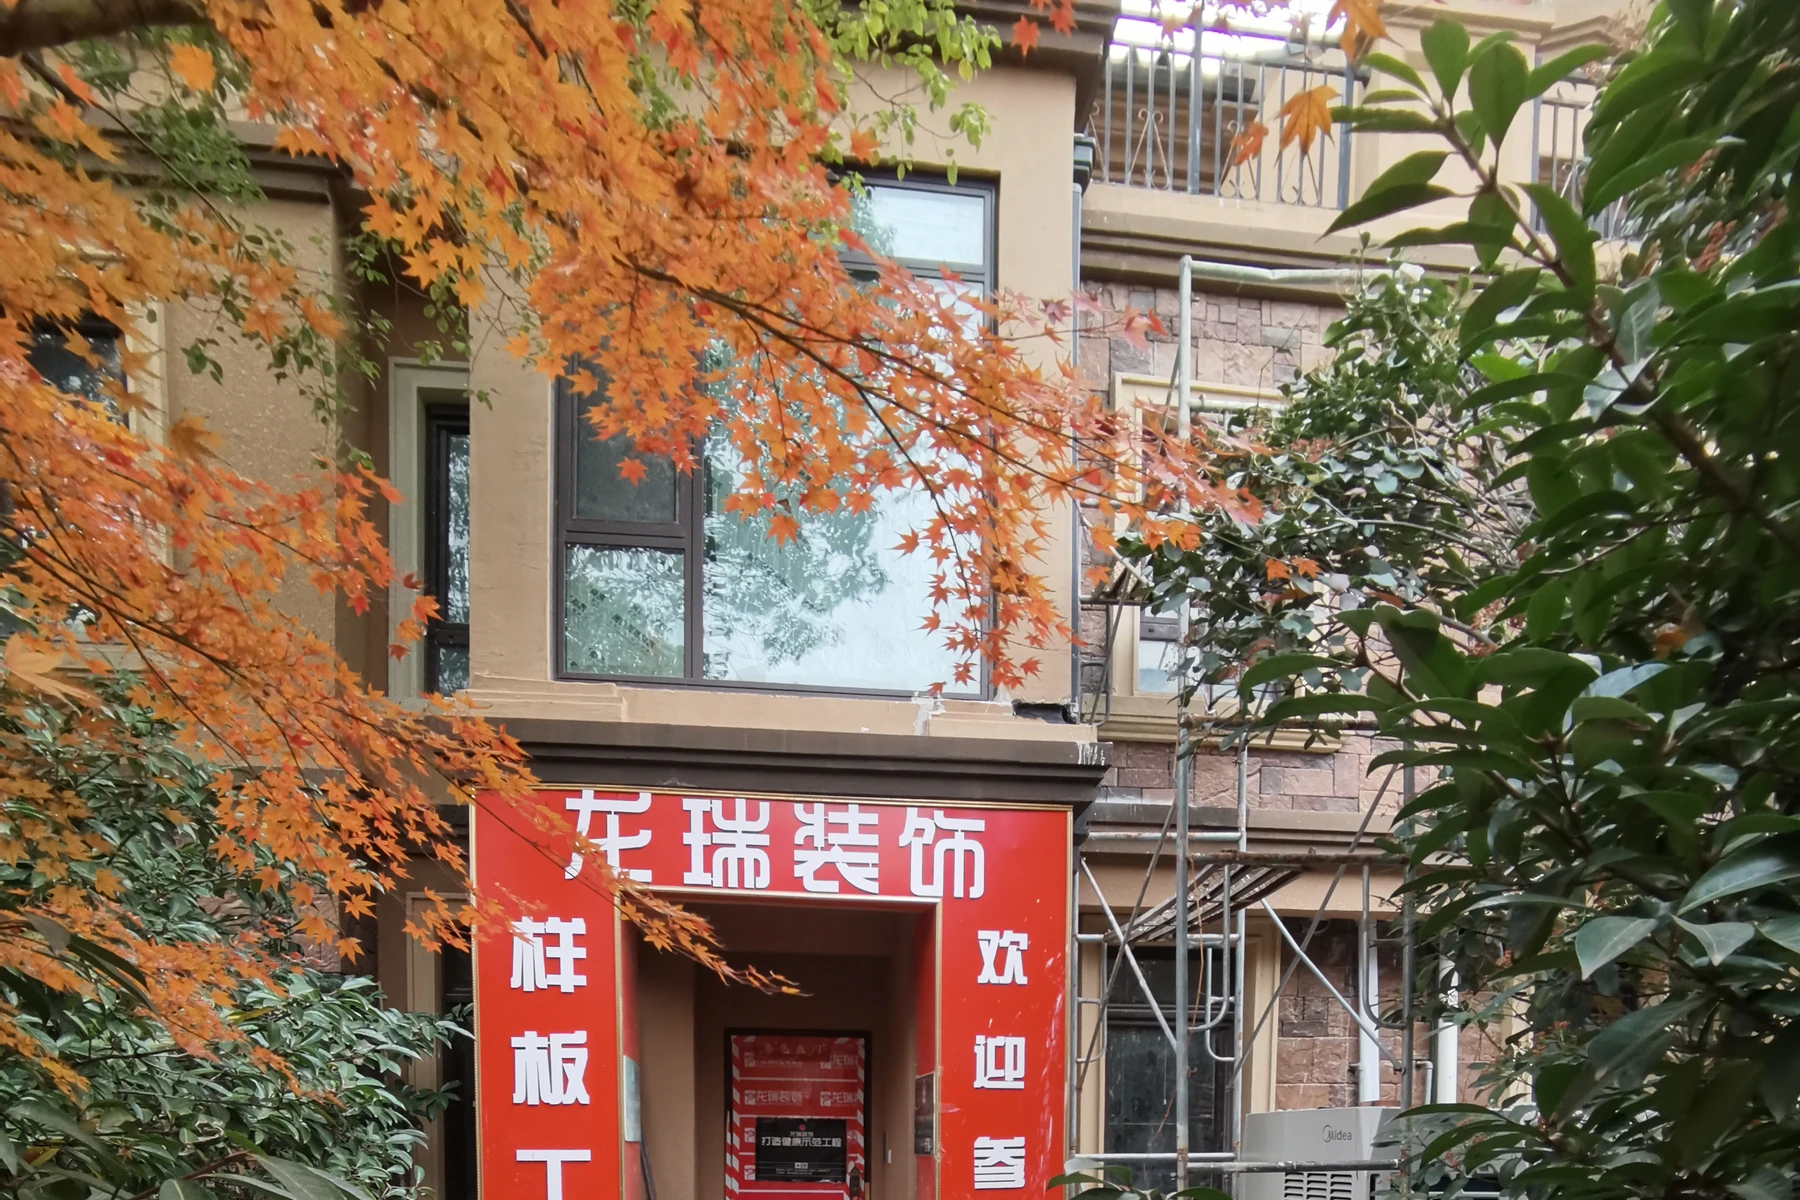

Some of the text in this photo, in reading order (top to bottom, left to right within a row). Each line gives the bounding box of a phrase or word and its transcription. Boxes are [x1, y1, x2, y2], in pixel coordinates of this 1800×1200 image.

[565, 789, 986, 899] 龙瑞装饰
[831, 1092, 857, 1104] 龙瑞
[1322, 1124, 1352, 1143] Midea
